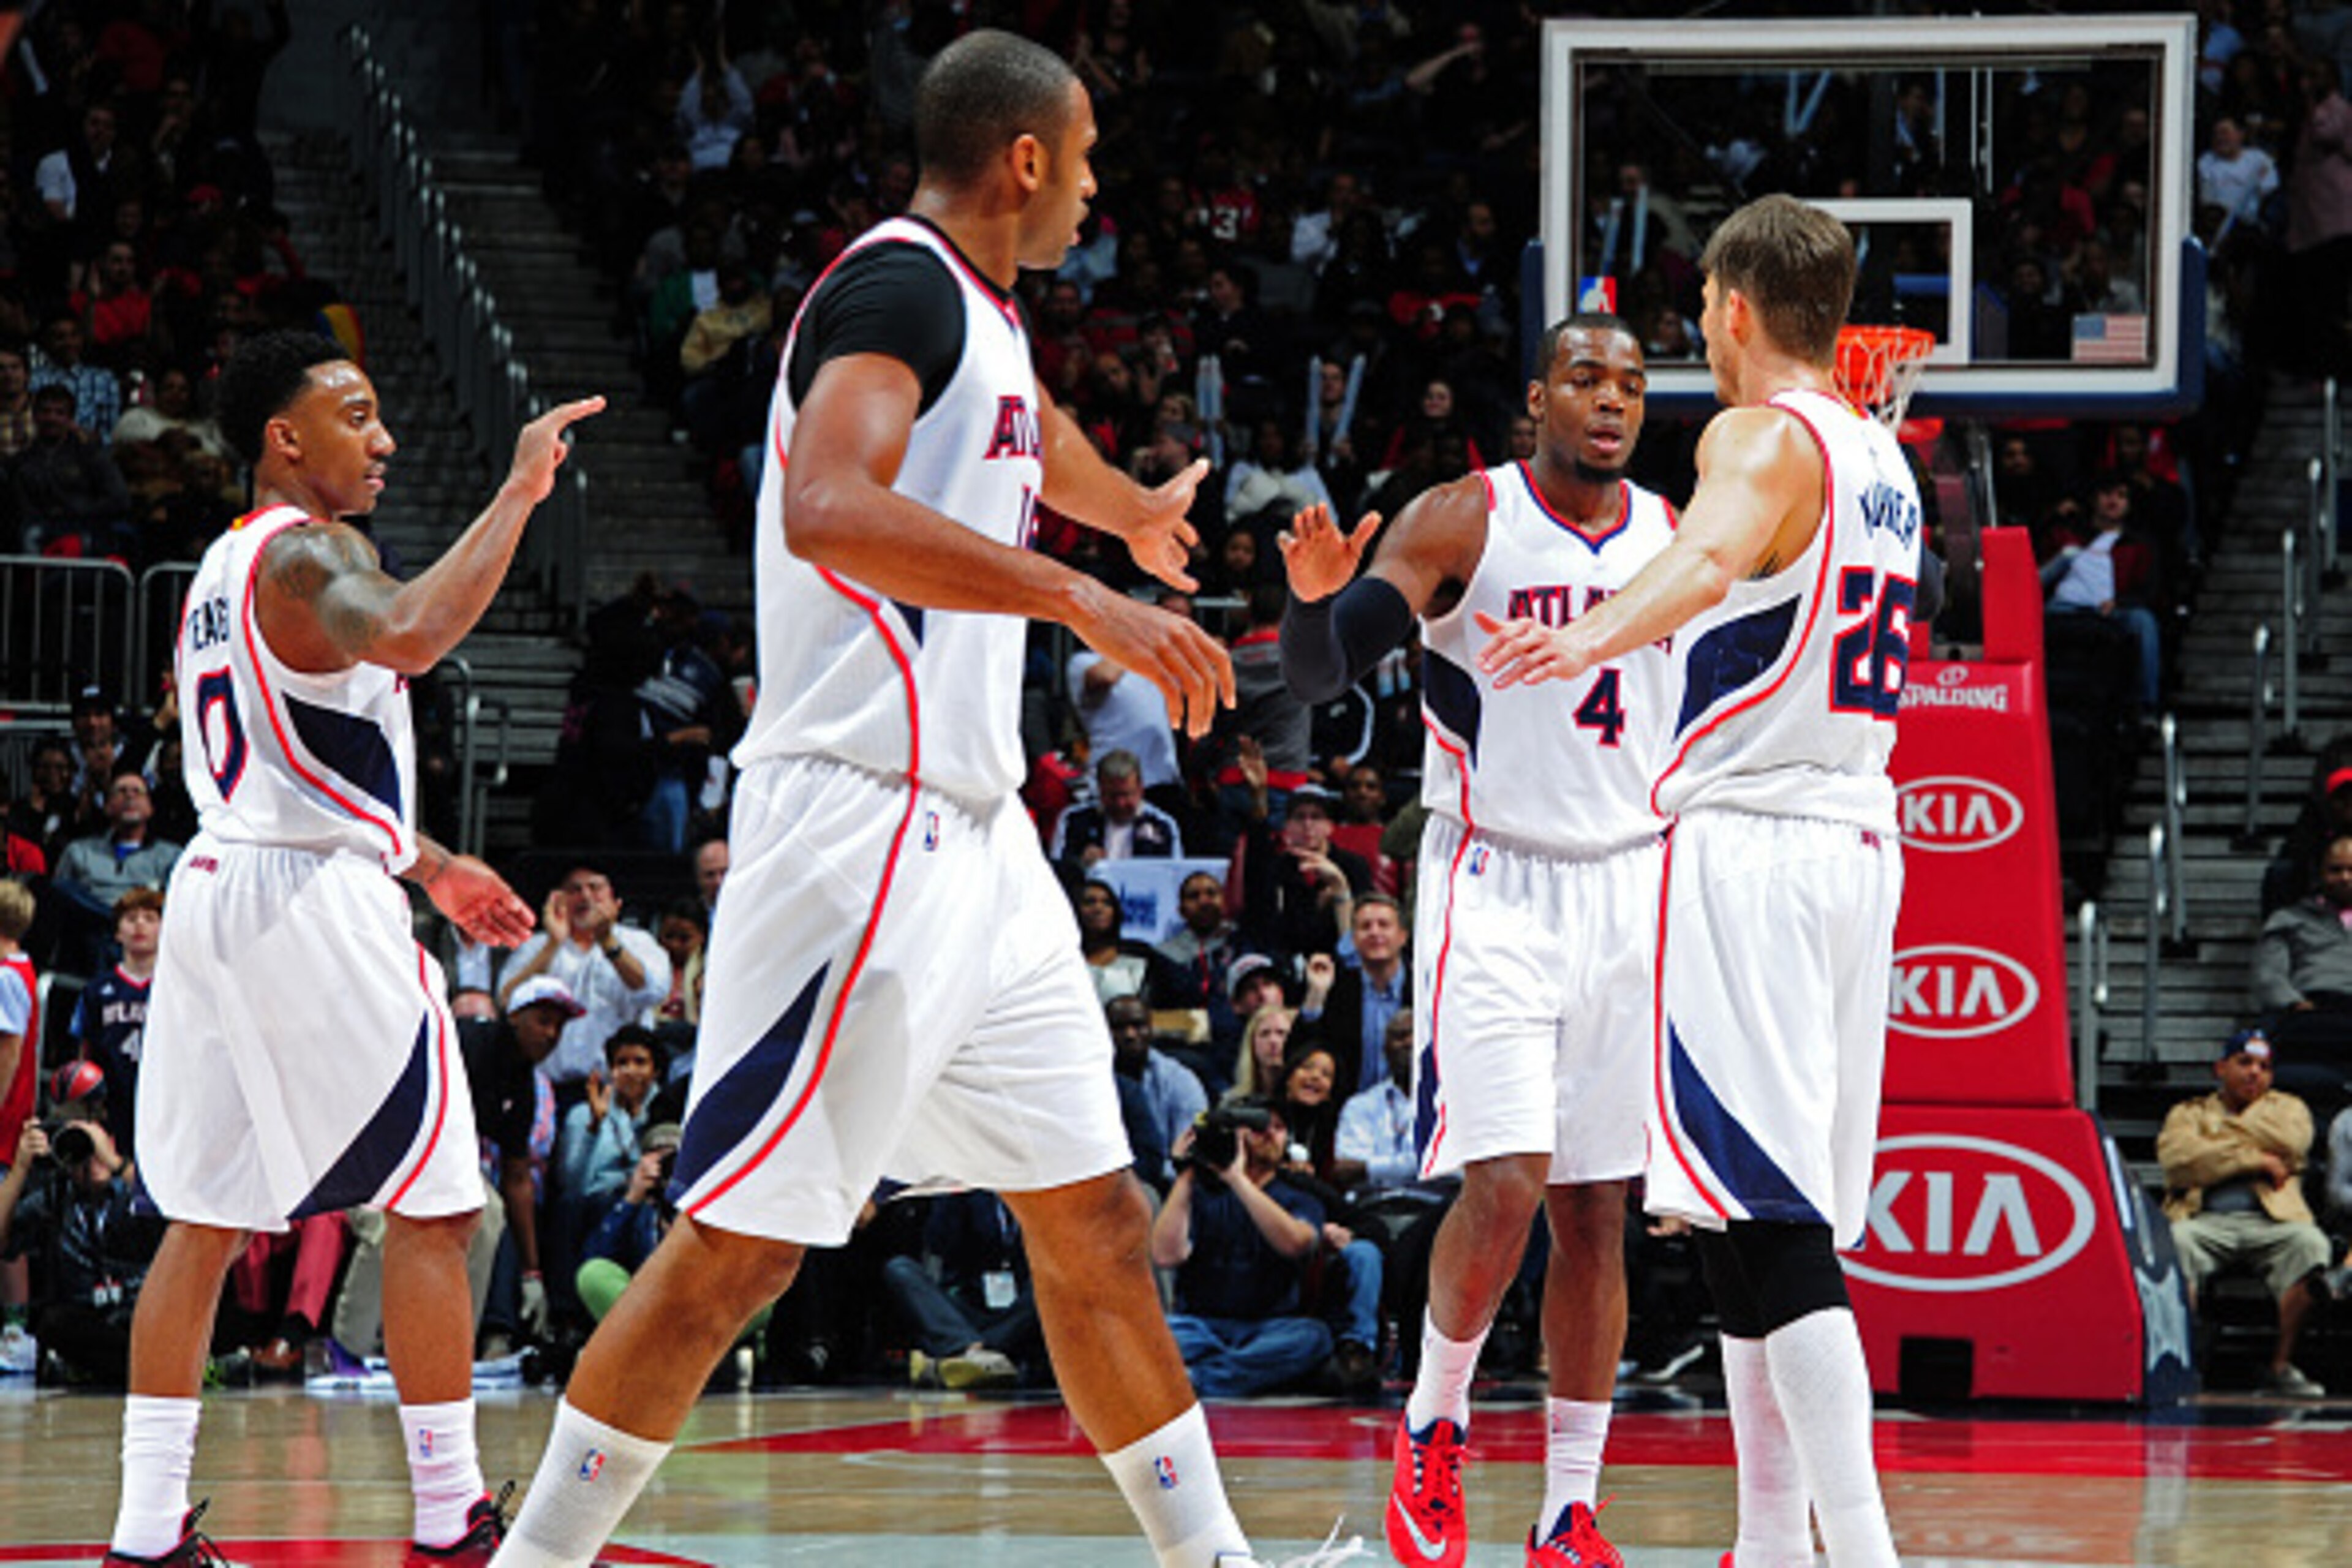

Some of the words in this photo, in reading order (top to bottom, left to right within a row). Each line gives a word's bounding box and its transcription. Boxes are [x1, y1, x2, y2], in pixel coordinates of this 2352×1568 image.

[1829, 566, 1918, 722] 26
[196, 665, 249, 804] 0
[1572, 666, 1626, 748] 4
[1897, 681, 2010, 714] SPALDING
[1903, 793, 1999, 835] KIA
[1890, 965, 2007, 1017] KIA
[1867, 1171, 2043, 1256] KIA
